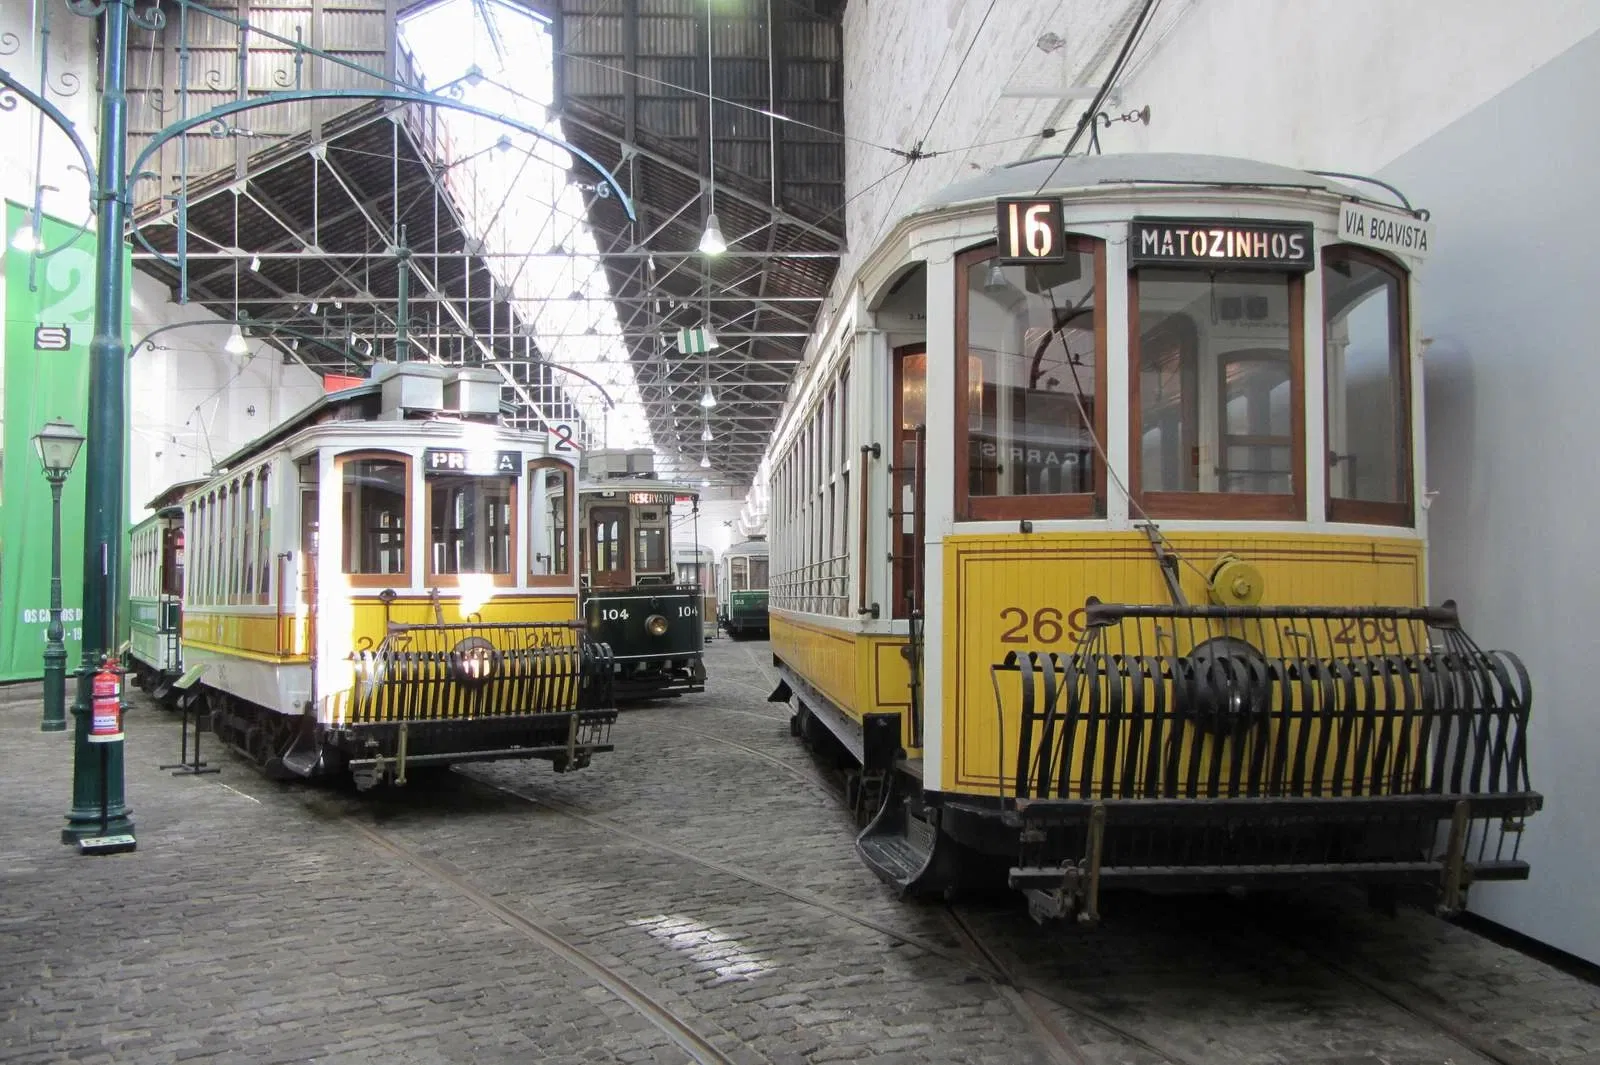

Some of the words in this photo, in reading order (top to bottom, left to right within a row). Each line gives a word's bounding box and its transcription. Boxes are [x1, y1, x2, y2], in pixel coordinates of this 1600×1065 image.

[1008, 204, 1052, 257] 16
[1346, 210, 1364, 237] VIA
[1370, 217, 1427, 251] BOAVISTA
[1141, 228, 1305, 260] MATOZINHOS
[37, 329, 67, 349] S
[432, 452, 513, 470] PRA
[629, 492, 675, 505] RESERVADO
[24, 608, 38, 623] OS
[602, 608, 629, 620] 104
[678, 606, 699, 617] 104
[1000, 606, 1088, 644] 269
